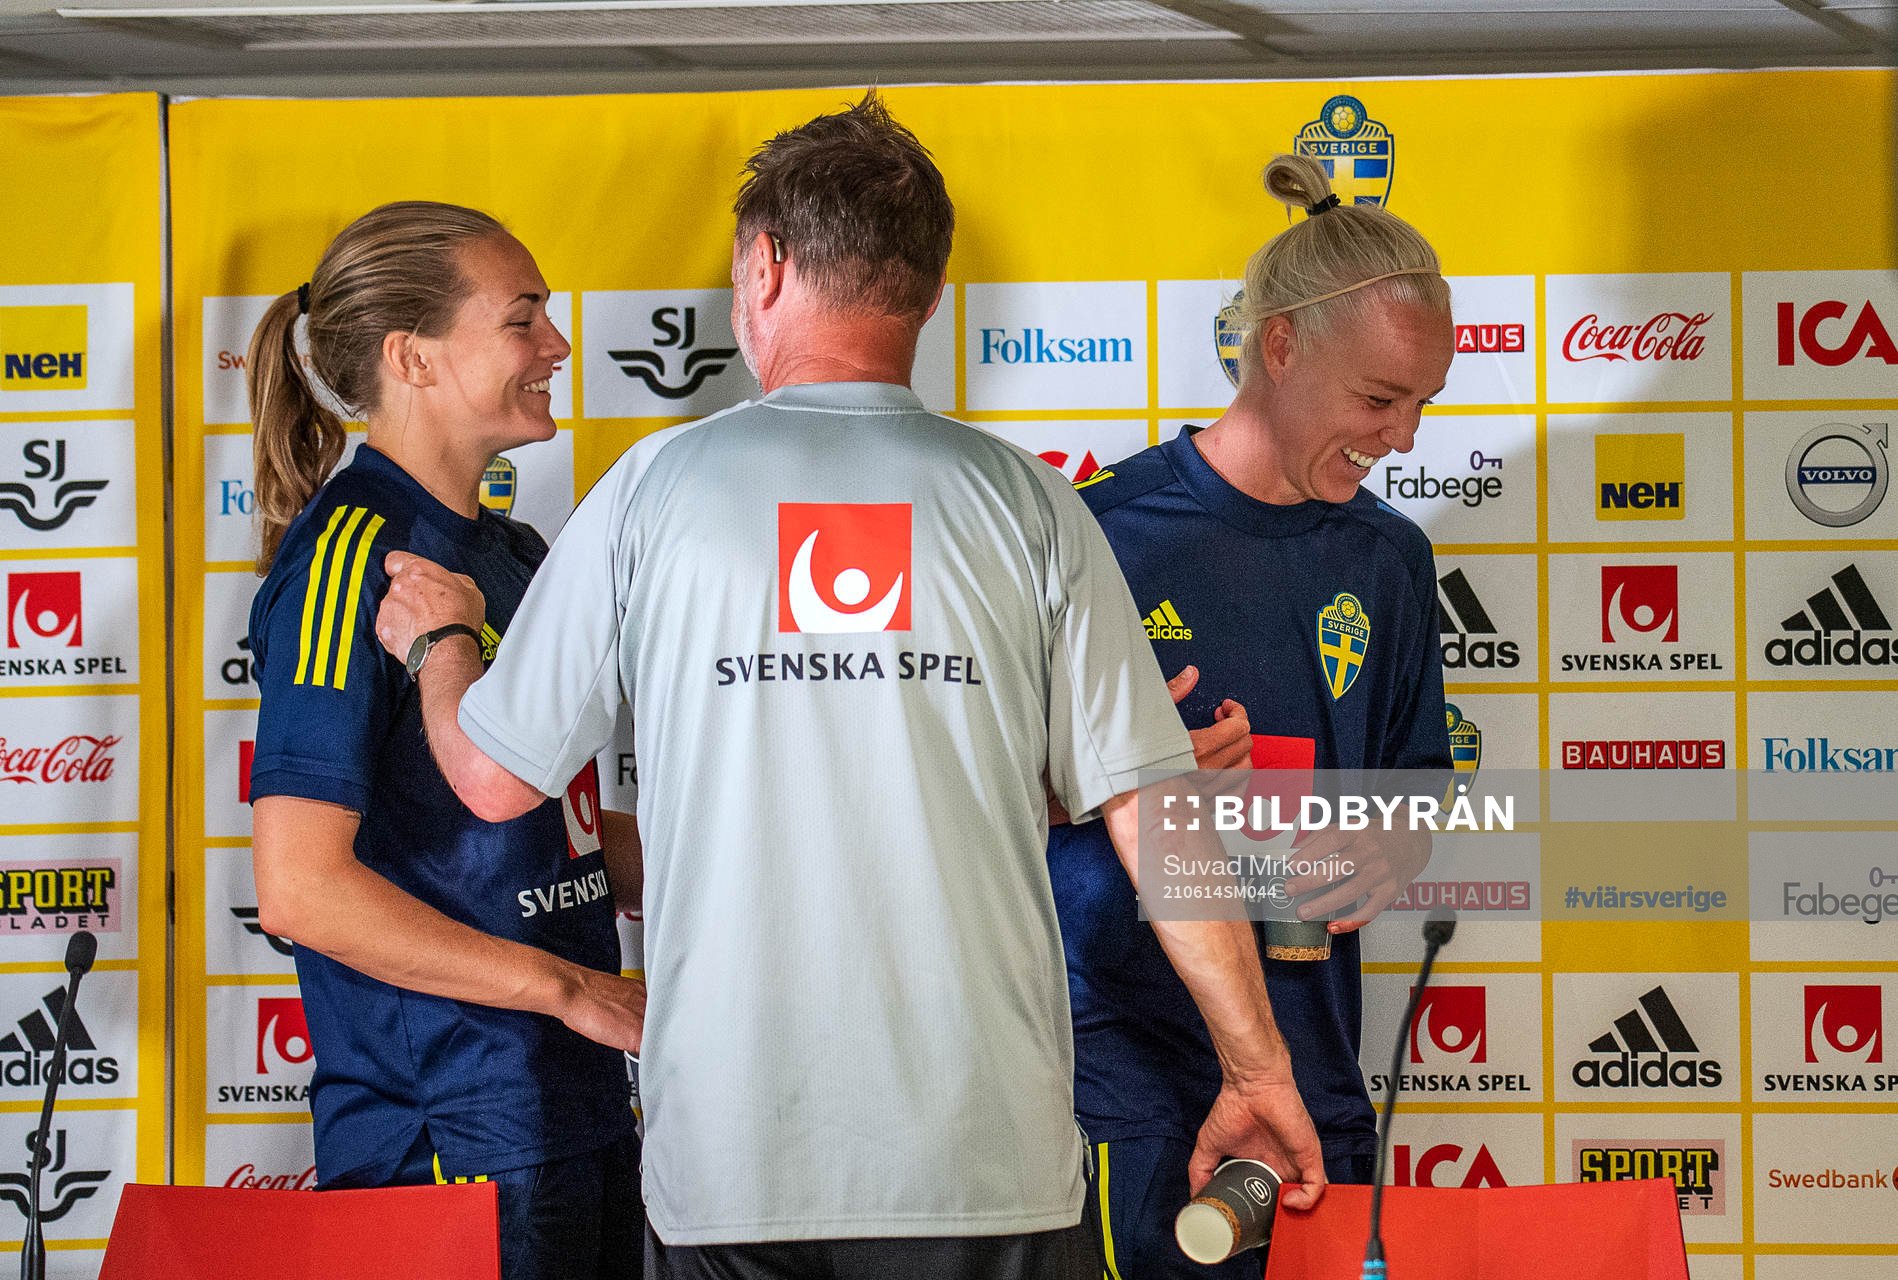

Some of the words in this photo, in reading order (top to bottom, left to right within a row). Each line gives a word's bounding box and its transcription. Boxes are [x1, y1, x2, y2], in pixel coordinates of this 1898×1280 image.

[1310, 143, 1378, 154] SVERIGE
[651, 306, 696, 350] SJ
[1562, 312, 1714, 363] Coca-Cola
[1778, 299, 1898, 366] ICA
[979, 328, 1133, 364] Folksam
[23, 439, 66, 481] SJ
[1801, 469, 1872, 481] VOLVO
[1386, 466, 1502, 507] Fabege
[1328, 620, 1364, 637] SVERIGE
[74, 657, 127, 674] SPEL
[716, 652, 885, 686] SVENSKA
[898, 651, 981, 685] SPEL
[1562, 653, 1662, 671] SVENSKA
[1670, 653, 1722, 670] SPEL
[1563, 742, 1724, 768] BAUHAUS
[0, 867, 115, 915] PORT
[1564, 885, 1727, 912] #viärsverige
[0, 914, 110, 930] LADET
[1478, 1075, 1531, 1091] SPEL
[1572, 1052, 1722, 1087] adidas
[1764, 1075, 1867, 1091] SVENSKA
[25, 1129, 67, 1172] SJ
[1394, 1143, 1508, 1188] ICA
[1580, 1149, 1718, 1194] SPORT
[1768, 1169, 1888, 1188] Swedbank
